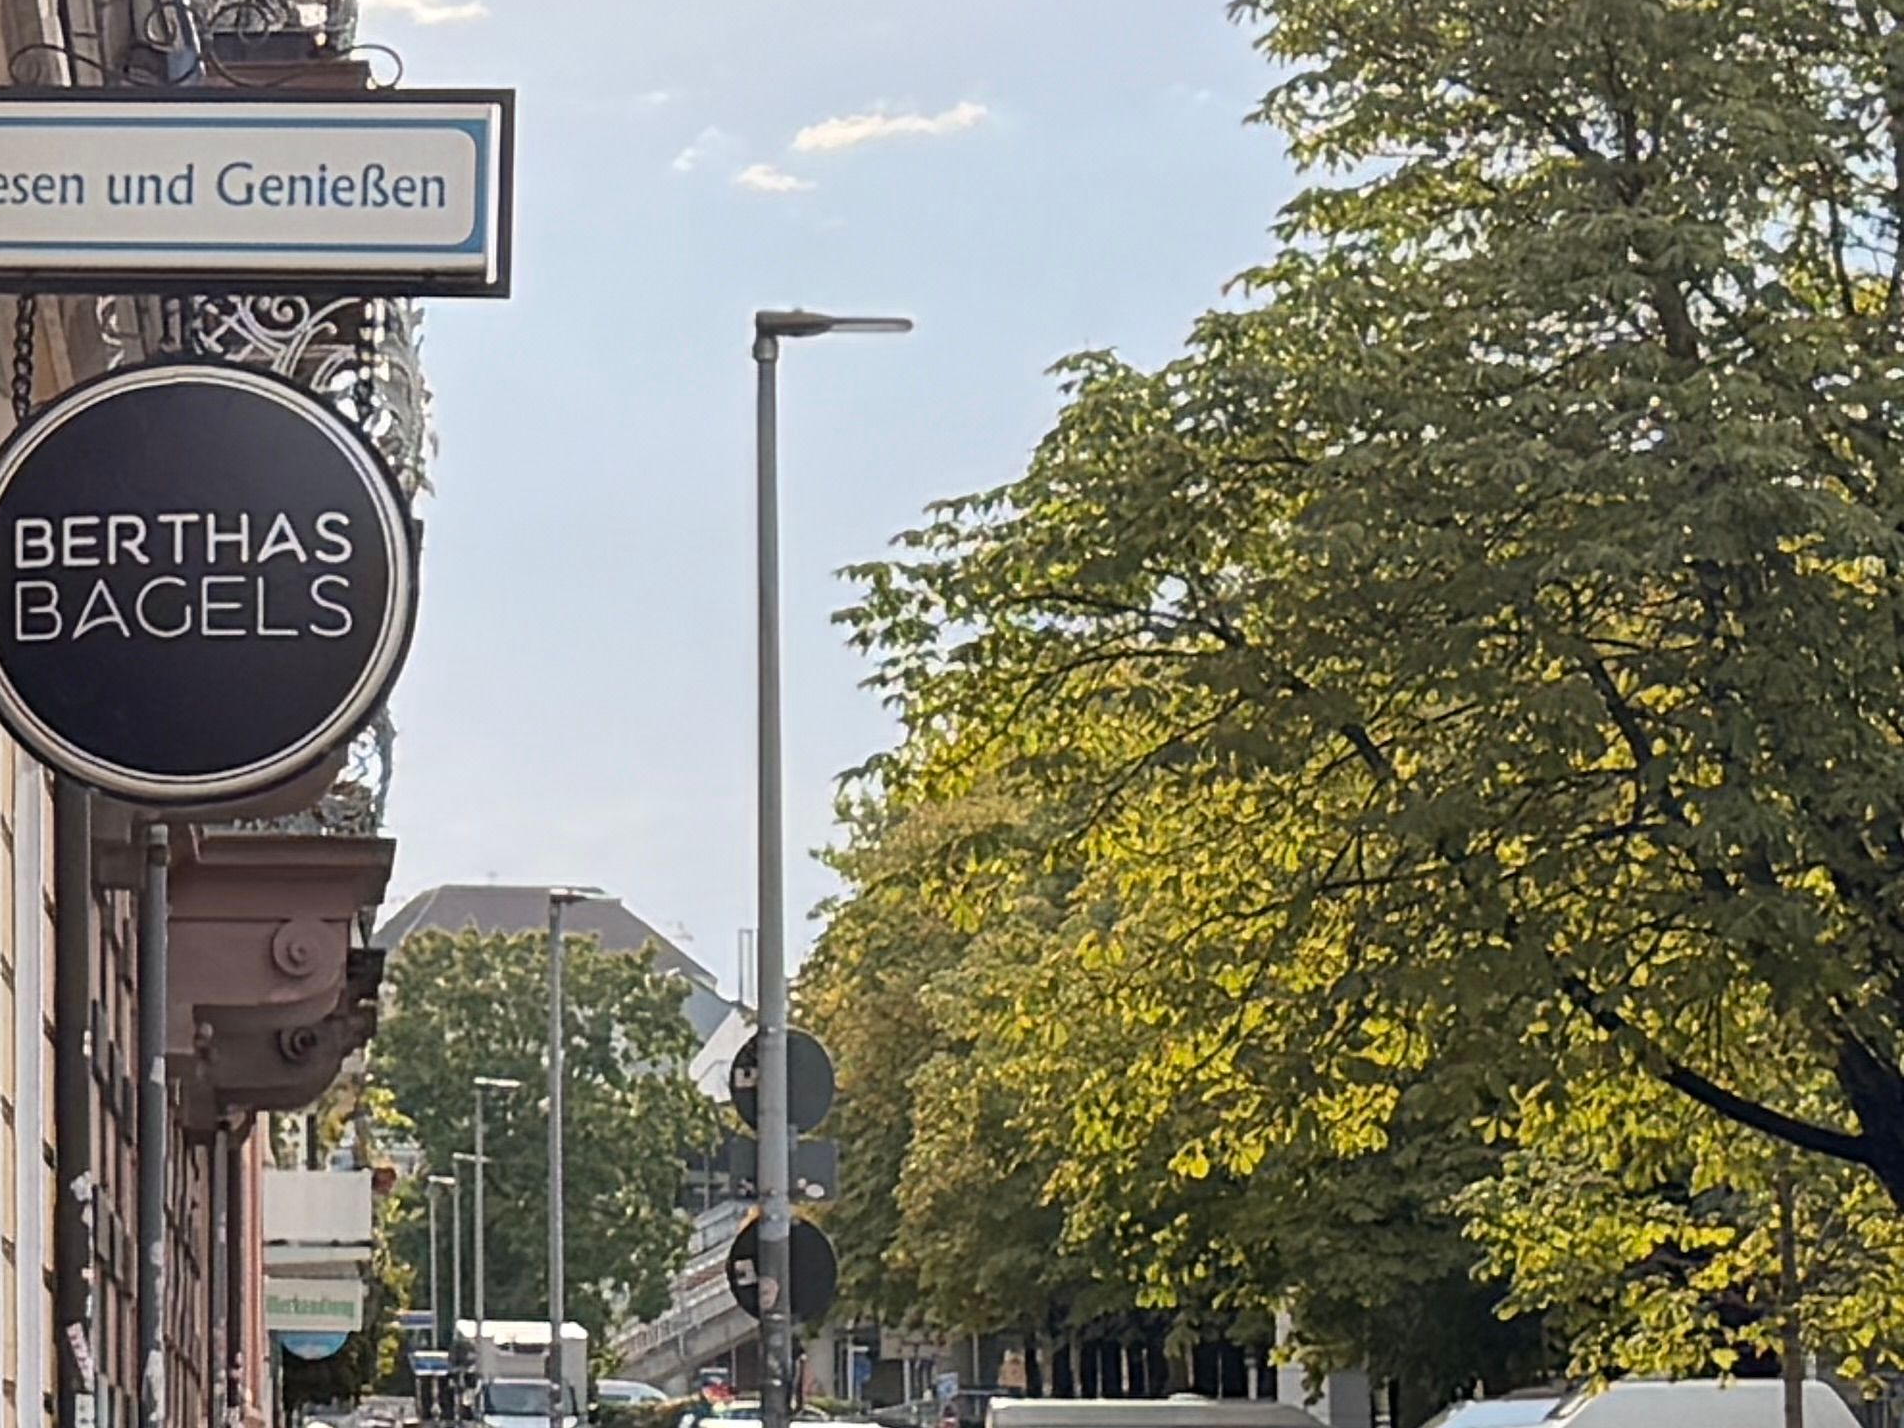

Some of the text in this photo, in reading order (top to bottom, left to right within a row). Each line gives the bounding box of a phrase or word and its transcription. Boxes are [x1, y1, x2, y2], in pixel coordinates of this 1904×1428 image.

[106, 163, 194, 208] und
[216, 161, 448, 210] Genießen
[14, 512, 353, 569] BERTHAS
[14, 574, 354, 641] BAGELS
